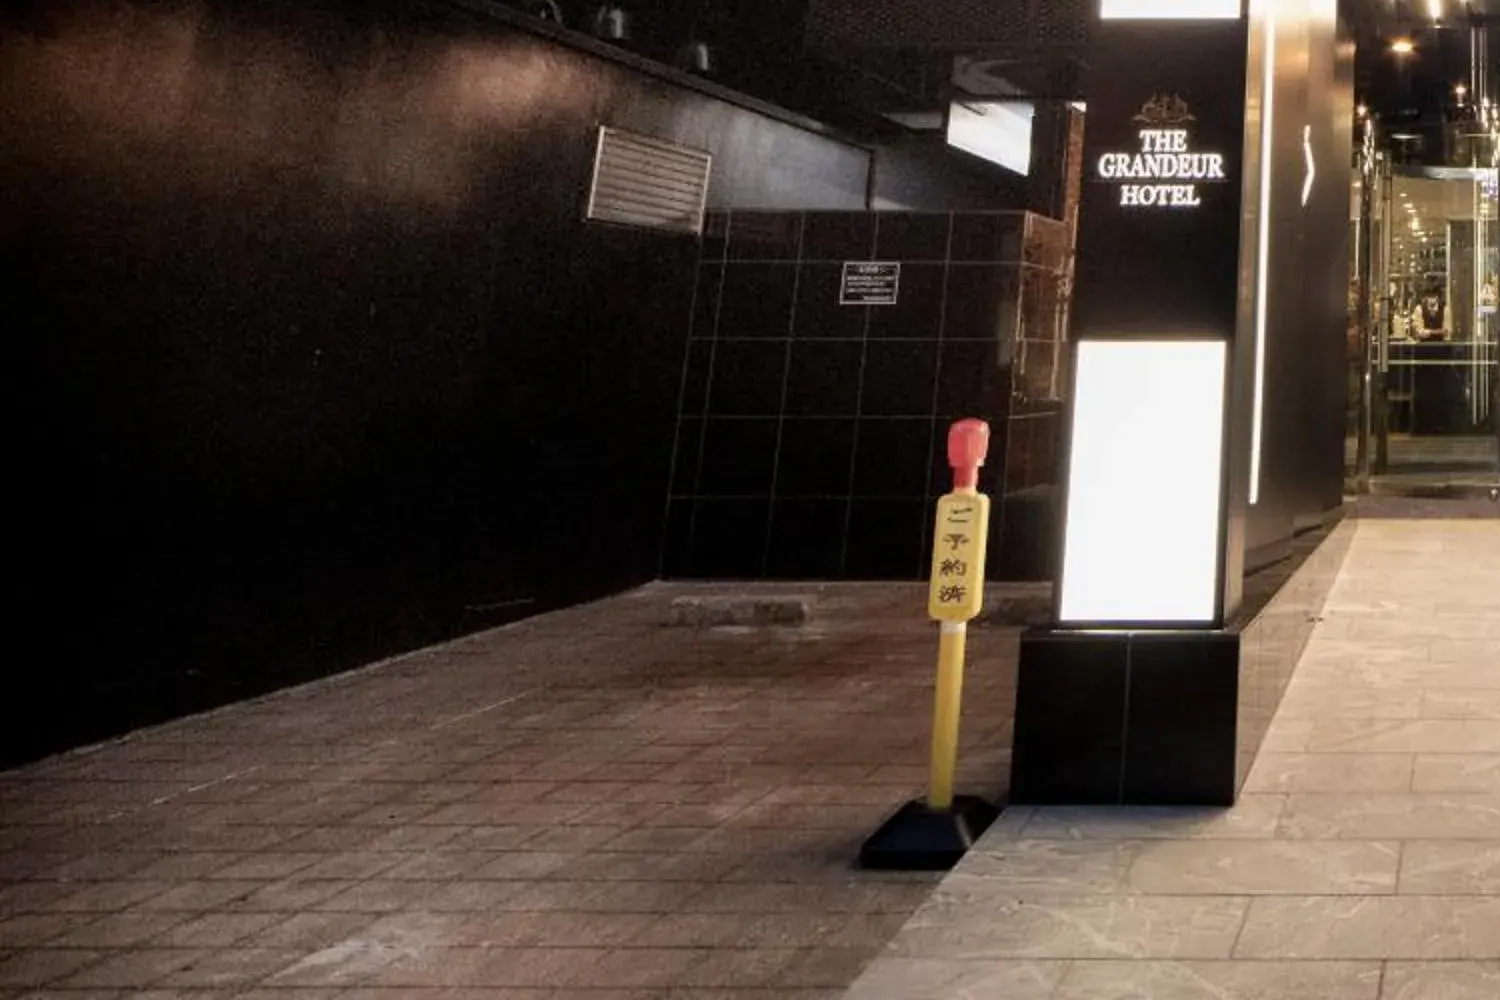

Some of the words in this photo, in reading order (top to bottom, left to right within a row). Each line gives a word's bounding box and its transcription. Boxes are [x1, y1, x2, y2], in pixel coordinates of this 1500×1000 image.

[1139, 128, 1187, 153] THE
[1098, 153, 1226, 178] GRANDEUR
[1119, 184, 1201, 206] HOTEL
